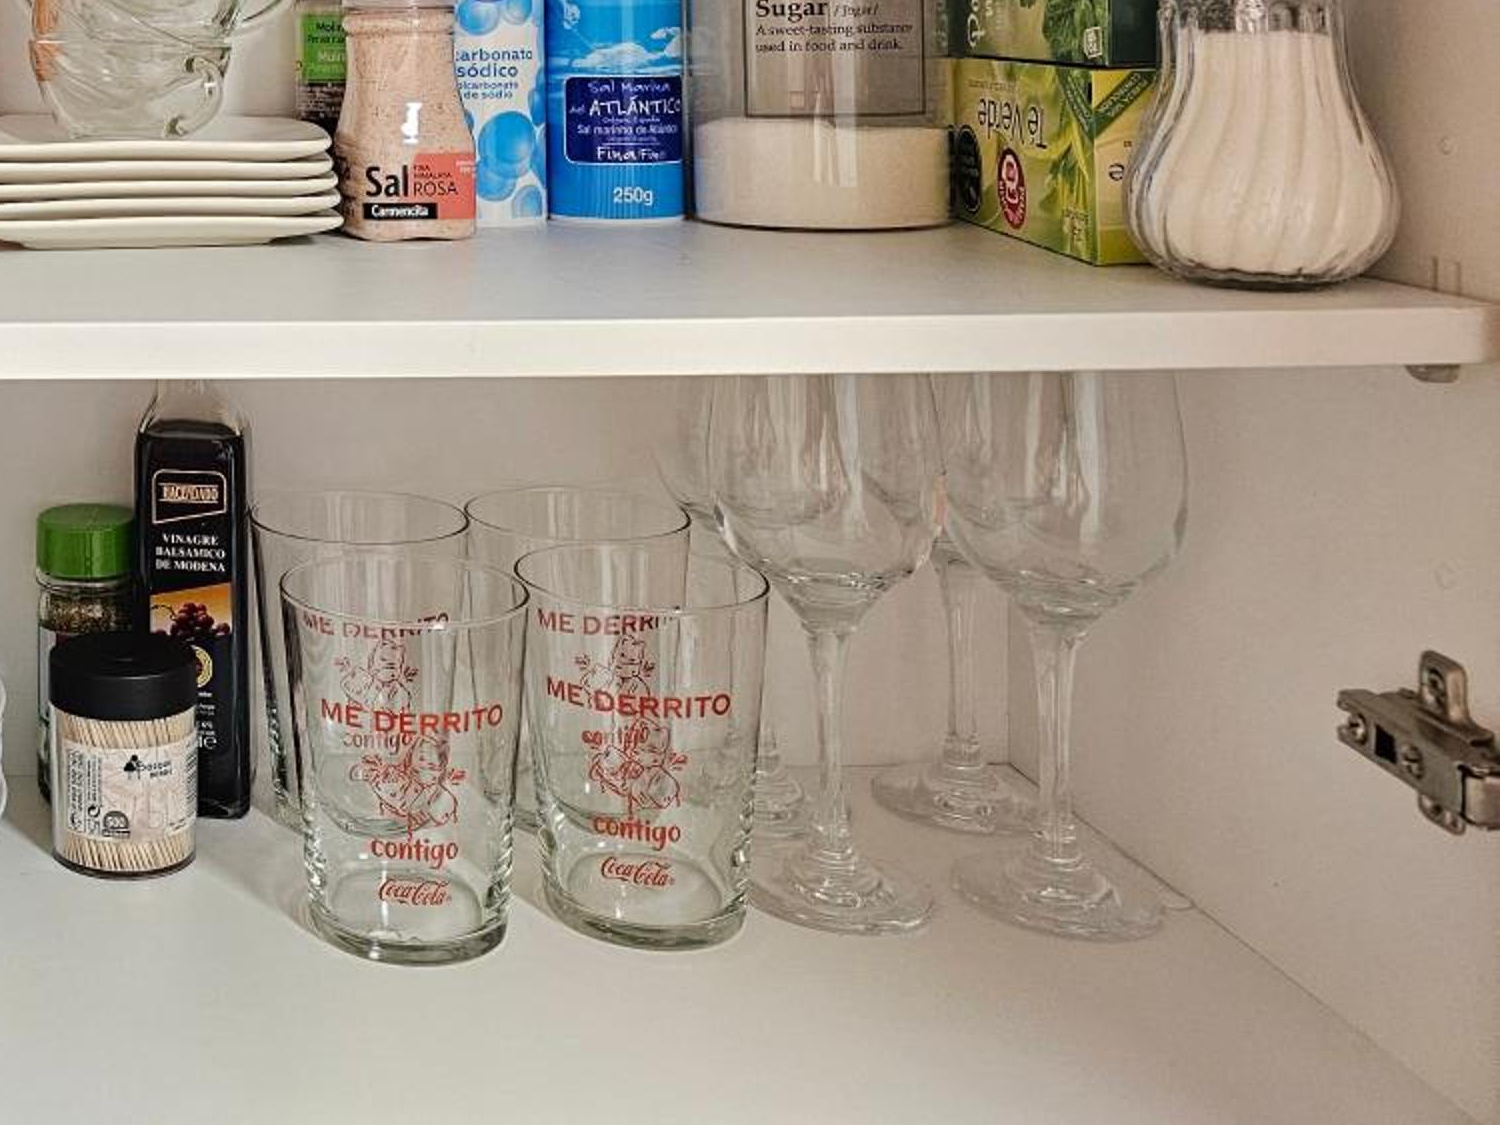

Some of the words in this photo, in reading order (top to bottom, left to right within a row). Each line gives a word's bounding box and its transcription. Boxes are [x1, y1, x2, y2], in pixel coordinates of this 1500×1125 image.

[755, 24, 767, 36] A
[769, 24, 853, 37] sweet-tasting
[755, 40, 785, 52] used
[789, 40, 803, 52] in
[805, 39, 837, 52] food
[839, 39, 865, 51] and
[457, 62, 519, 78] sódico
[587, 80, 616, 94] Sal
[589, 95, 681, 117] ATLÁNTICO
[977, 98, 1026, 144] Verde
[1027, 106, 1049, 150] Té
[365, 165, 409, 197] Sal
[413, 181, 459, 196] ROSA
[612, 186, 654, 206] 250g
[162, 533, 219, 546] VINAGRE
[155, 558, 171, 570] DE
[173, 560, 226, 572] MODENA
[538, 608, 575, 634] ME
[547, 675, 584, 707] ME
[594, 692, 732, 719] DERRITO
[320, 697, 363, 728] ME
[373, 703, 503, 735] DERRITO
[592, 815, 682, 851] contigo
[370, 838, 459, 869] contigo
